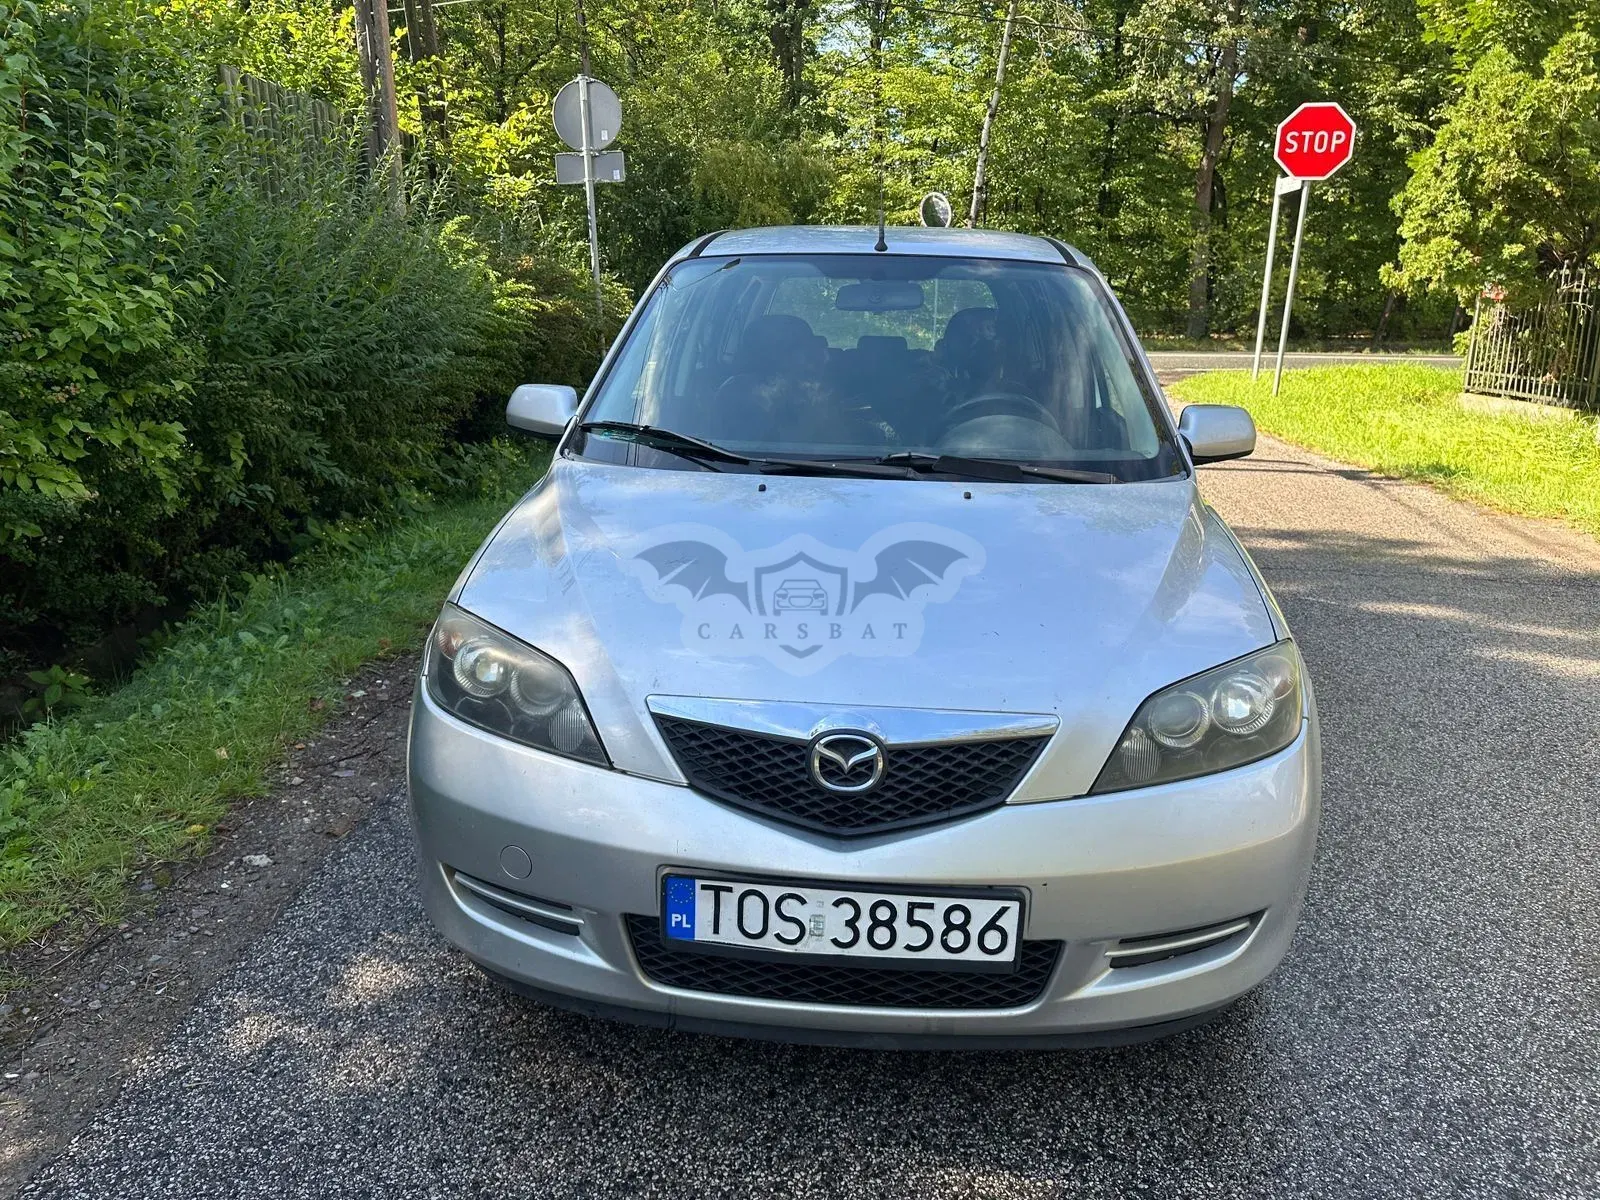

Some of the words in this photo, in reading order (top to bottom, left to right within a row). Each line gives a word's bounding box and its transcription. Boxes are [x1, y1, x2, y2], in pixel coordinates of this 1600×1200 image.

[1284, 130, 1346, 153] STOP
[671, 913, 691, 929] PL
[700, 884, 808, 945] TOS
[830, 897, 1011, 956] 38586
